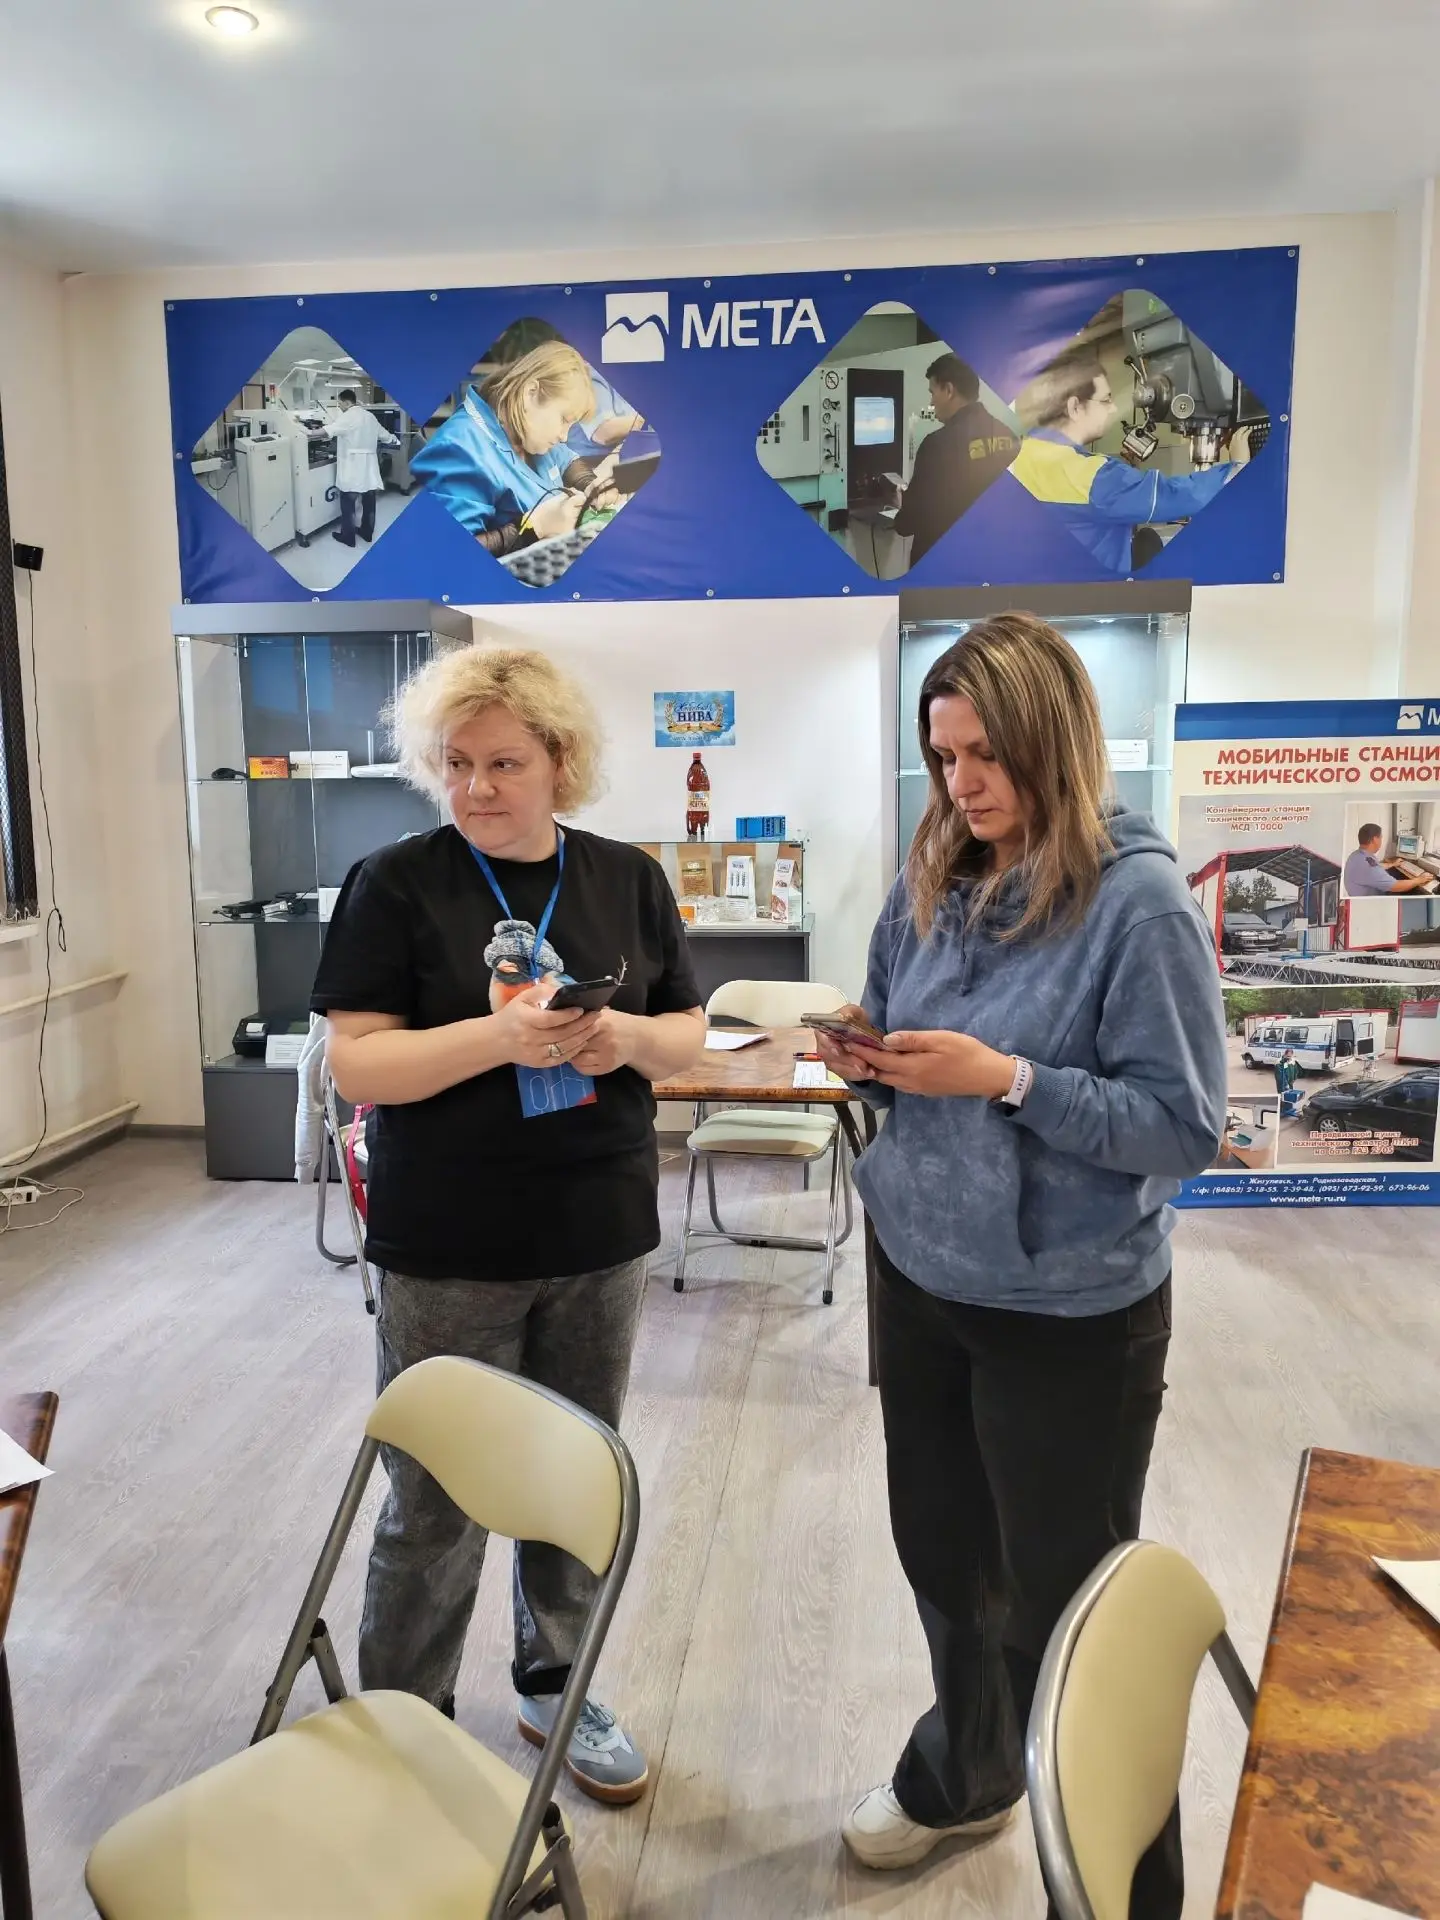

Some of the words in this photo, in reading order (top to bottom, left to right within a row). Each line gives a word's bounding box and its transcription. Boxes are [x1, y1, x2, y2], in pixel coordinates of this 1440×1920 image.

[681, 298, 827, 349] МЕТА
[677, 711, 713, 722] НИВА
[1217, 747, 1350, 765] МОБИЛЬНЫЕ
[1358, 746, 1440, 763] СТАНЦИ
[1202, 766, 1361, 786] ТЕХНИЧЕСКОГО
[1369, 765, 1440, 783] ОСМОТ
[1273, 805, 1311, 814] станция
[1206, 815, 1268, 823] технического
[1271, 815, 1309, 824] осмотра
[1374, 1131, 1402, 1140] пункт
